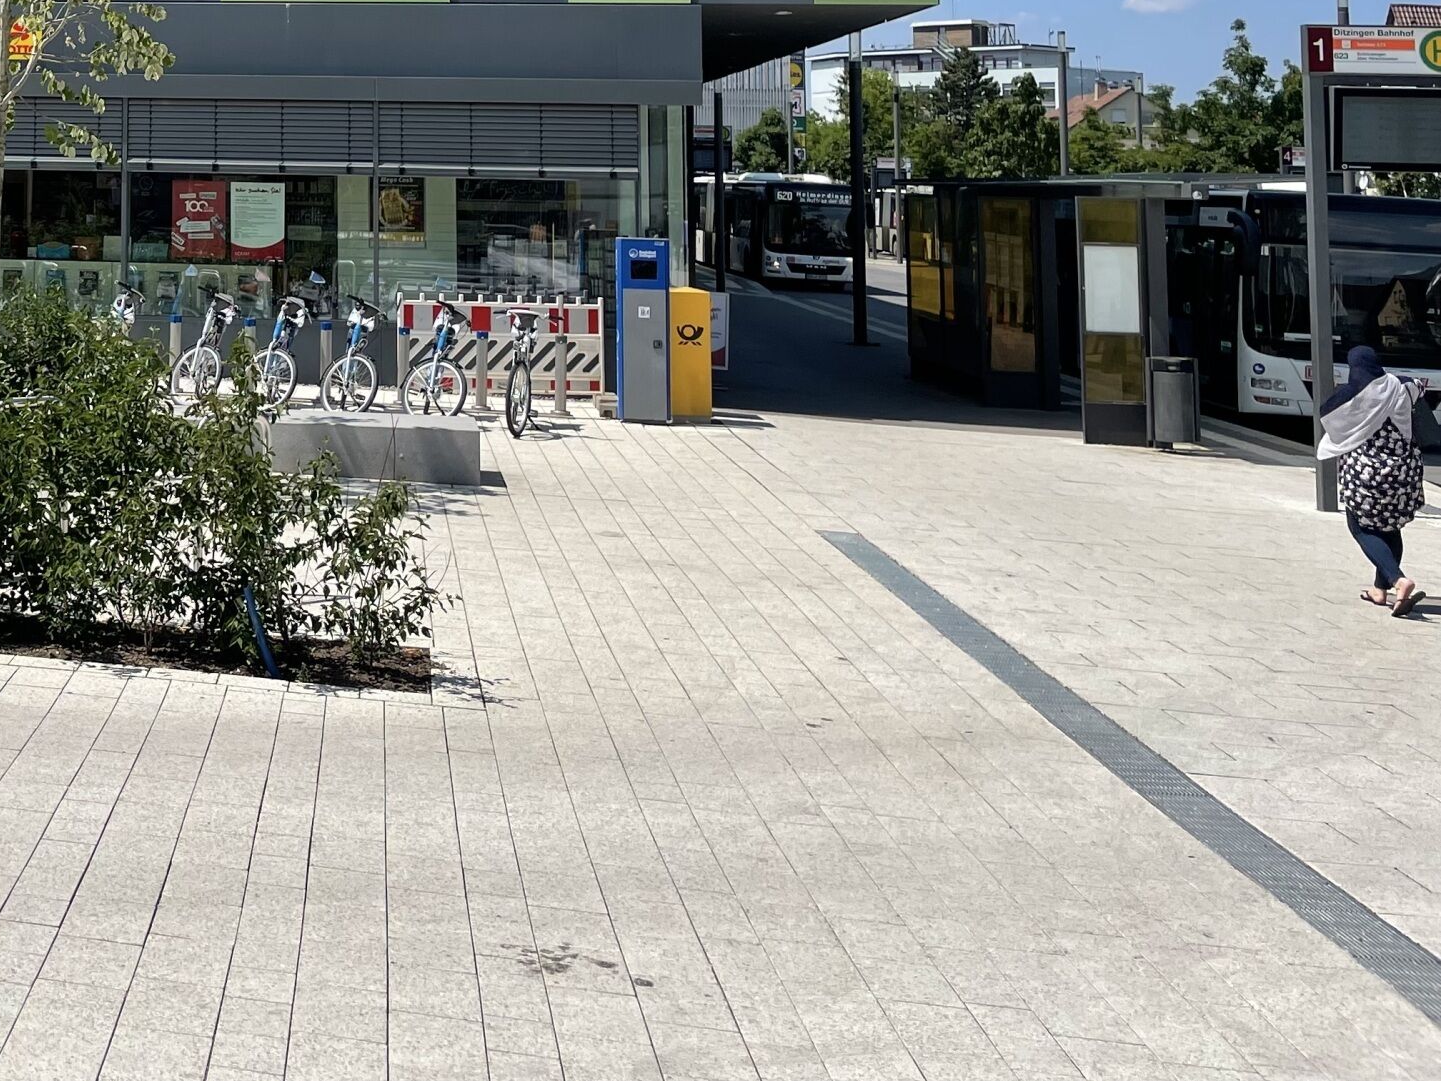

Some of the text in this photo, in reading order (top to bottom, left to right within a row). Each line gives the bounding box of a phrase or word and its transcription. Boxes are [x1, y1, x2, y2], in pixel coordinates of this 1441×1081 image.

[1334, 29, 1414, 38] Ditzingen Bahnhof
[1312, 37, 1324, 62] 1
[1283, 151, 1292, 162] 4
[776, 190, 793, 201] 620
